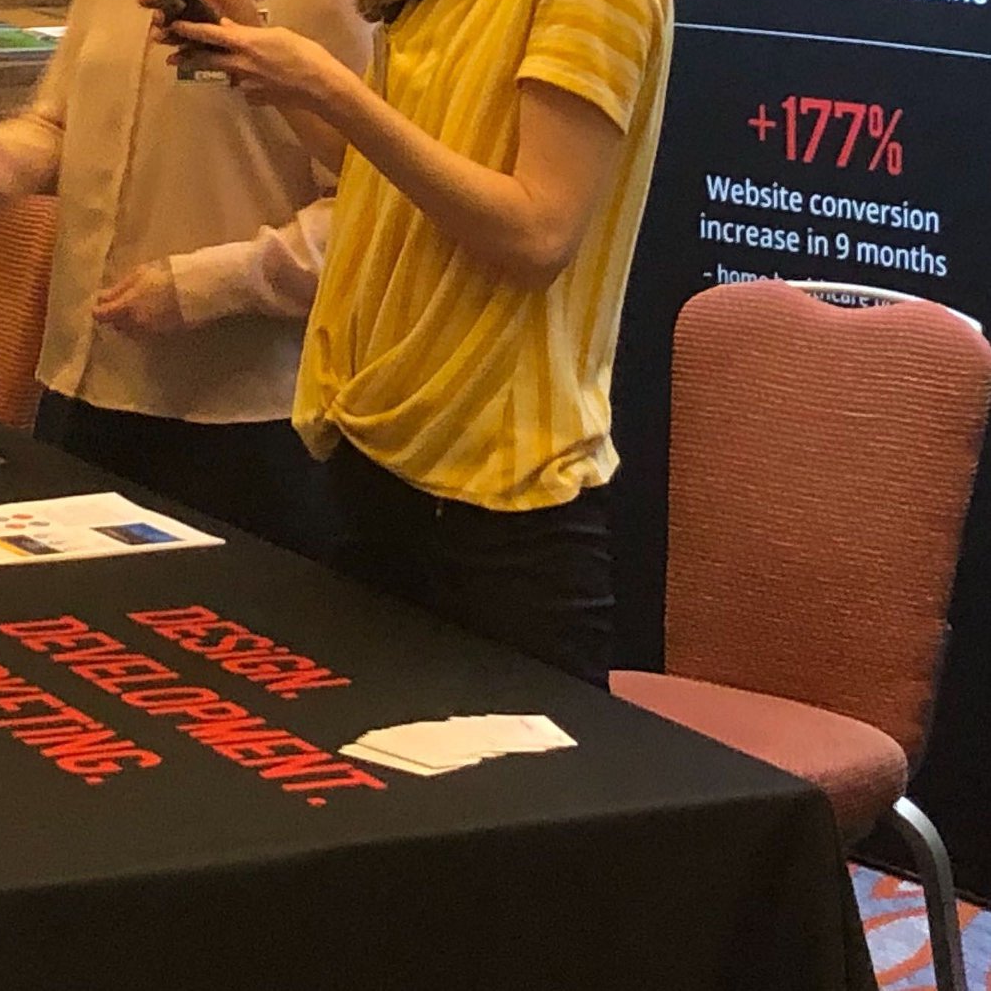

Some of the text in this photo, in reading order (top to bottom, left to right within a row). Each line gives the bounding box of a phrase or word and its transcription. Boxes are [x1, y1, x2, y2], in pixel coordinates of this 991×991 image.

[747, 95, 904, 176] +177%
[706, 174, 940, 234] Website conversion
[699, 212, 949, 277] increase in 9 months
